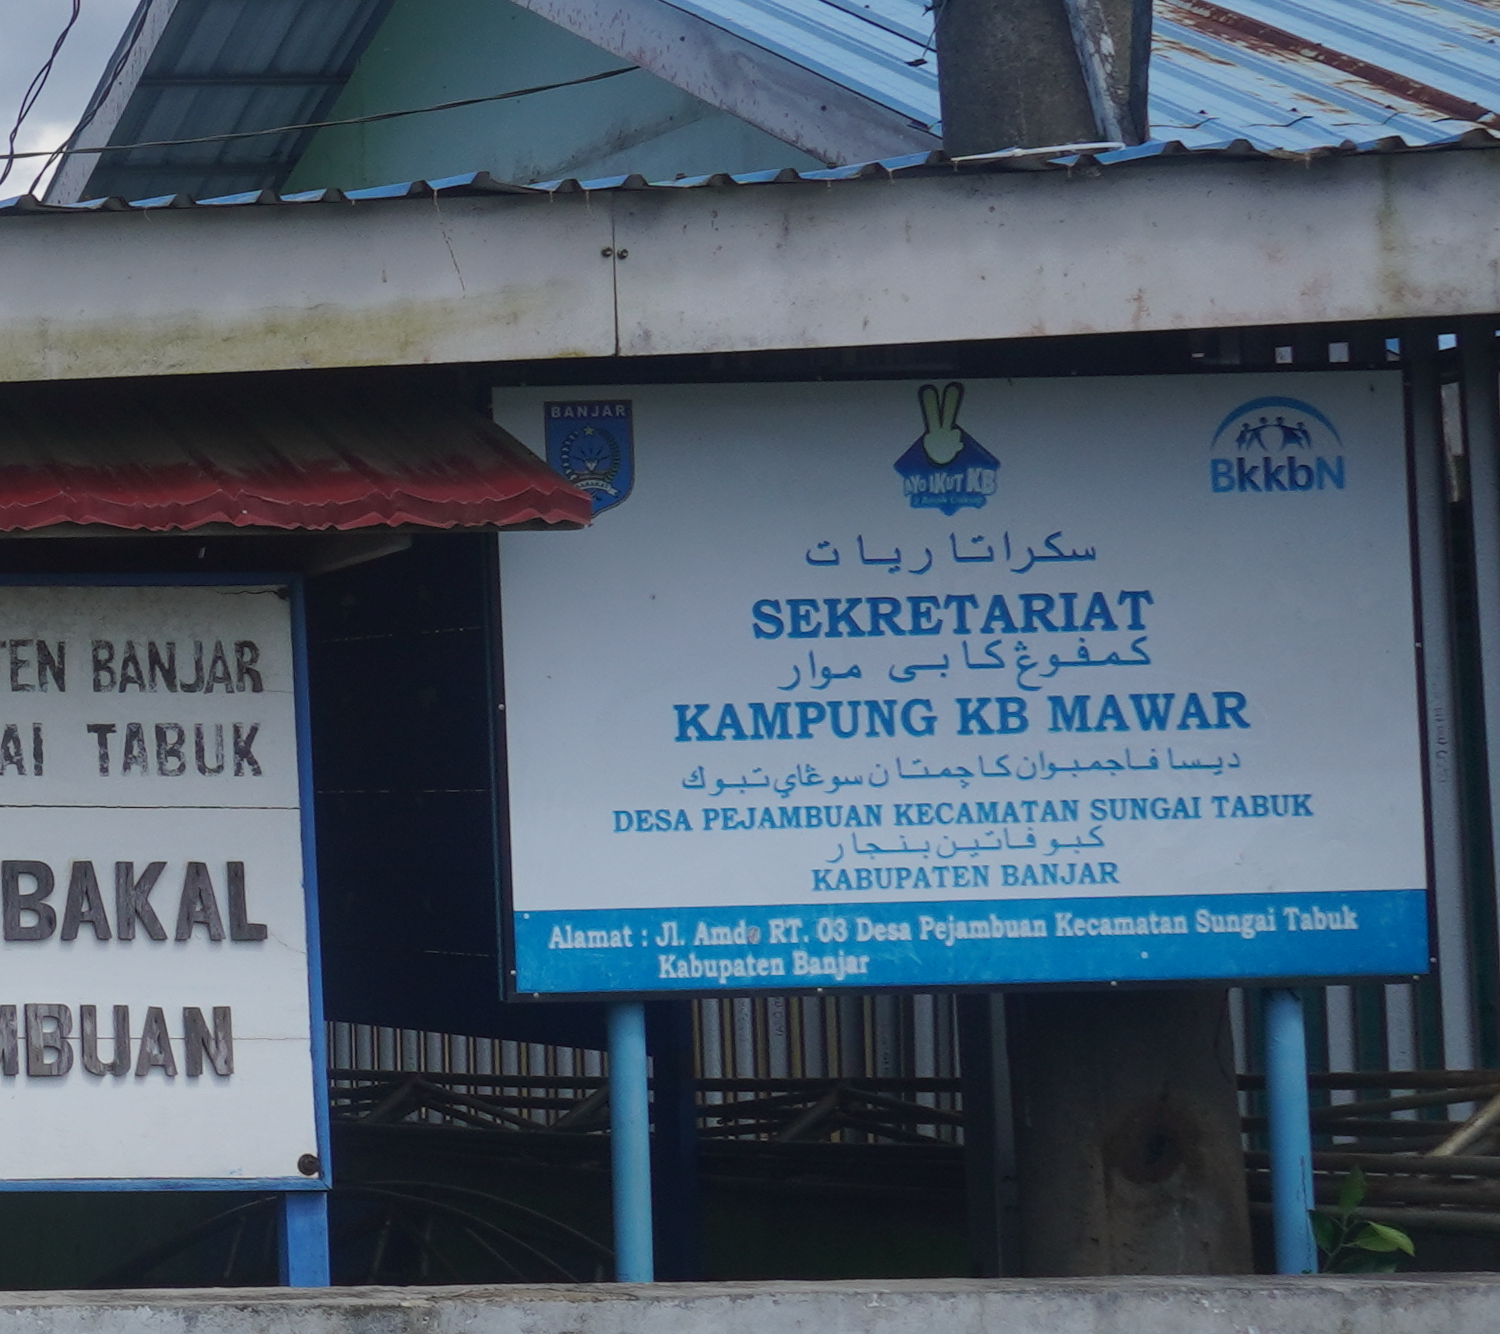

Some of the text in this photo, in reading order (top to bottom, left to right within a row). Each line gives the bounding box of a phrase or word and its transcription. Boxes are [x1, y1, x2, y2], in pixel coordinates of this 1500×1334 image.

[551, 404, 626, 417] BANJAR
[903, 467, 997, 496] AYO IKUT KB
[1210, 455, 1345, 493] BkkbN
[752, 590, 1155, 640] SEKRETARIAT
[92, 639, 264, 695] BANJAR
[674, 690, 1251, 742] KAMPUNG KB MAWAR
[87, 722, 263, 779] TABUK
[612, 792, 1313, 834] DESA PEJAMBUAN KECAMATAN SUNGAI TABUK
[812, 861, 1120, 892] KABUPATEN BANJAR
[549, 925, 634, 949] Alamat
[641, 929, 649, 947] :
[656, 921, 685, 949] Jl.
[769, 918, 809, 944] RT.
[816, 916, 848, 942] 03
[856, 916, 911, 942] Desa
[919, 913, 1047, 951] Pejambuan
[1055, 909, 1188, 938] Kecamatan
[1195, 907, 1277, 940] Sungai
[1283, 904, 1358, 932] Tabuk
[658, 949, 870, 984] Kabupaten Banjar
